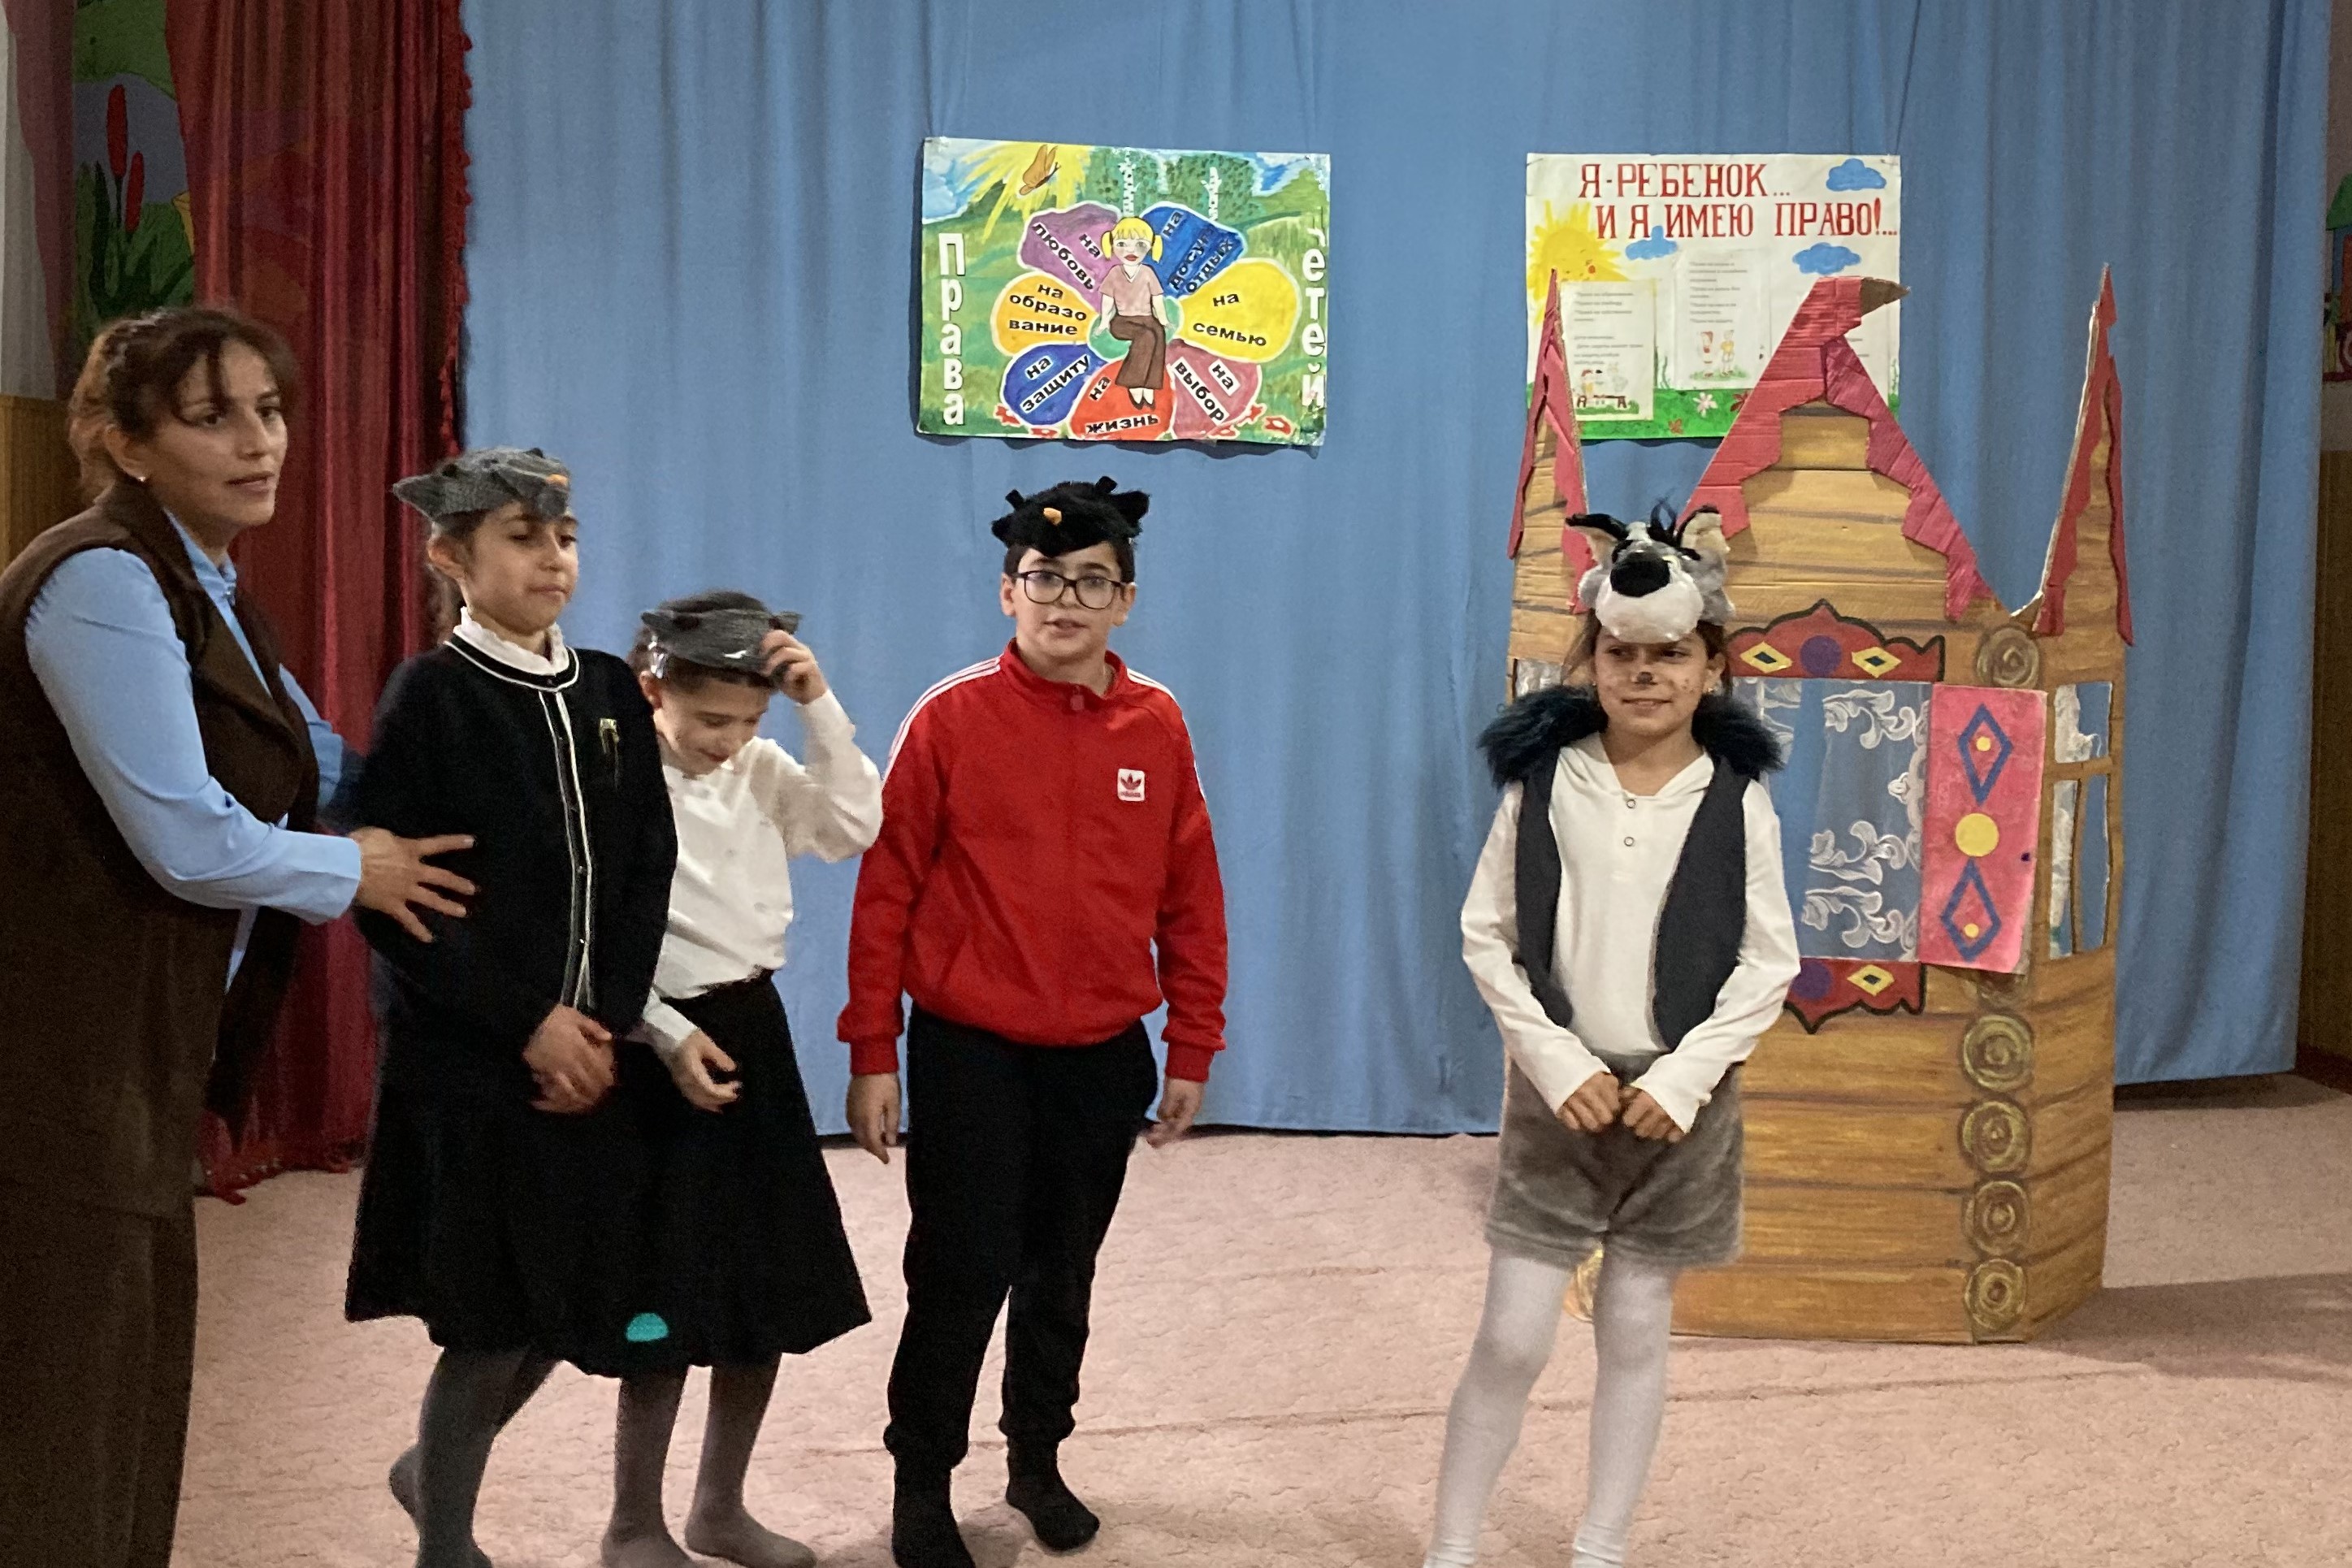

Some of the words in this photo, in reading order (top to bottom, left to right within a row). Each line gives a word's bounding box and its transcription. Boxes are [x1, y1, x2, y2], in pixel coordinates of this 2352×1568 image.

[1162, 211, 1184, 236] на
[1596, 205, 1617, 239] И
[1628, 204, 1651, 239] Я
[1664, 203, 1753, 237] ИМЕЮ
[1032, 223, 1094, 290] любовь
[1078, 233, 1101, 258] на
[1186, 239, 1233, 292] отдых
[1037, 284, 1063, 299] на
[1212, 293, 1240, 307] на
[1009, 294, 1087, 321] образо
[938, 233, 966, 426] Права
[1009, 319, 1078, 336] вание
[1193, 322, 1267, 347] семью
[1026, 357, 1051, 379] на
[1211, 364, 1234, 391] на
[1022, 354, 1089, 412] защиту
[1089, 376, 1111, 401] на
[1175, 362, 1225, 422] выбор
[1085, 414, 1159, 435] жизнь
